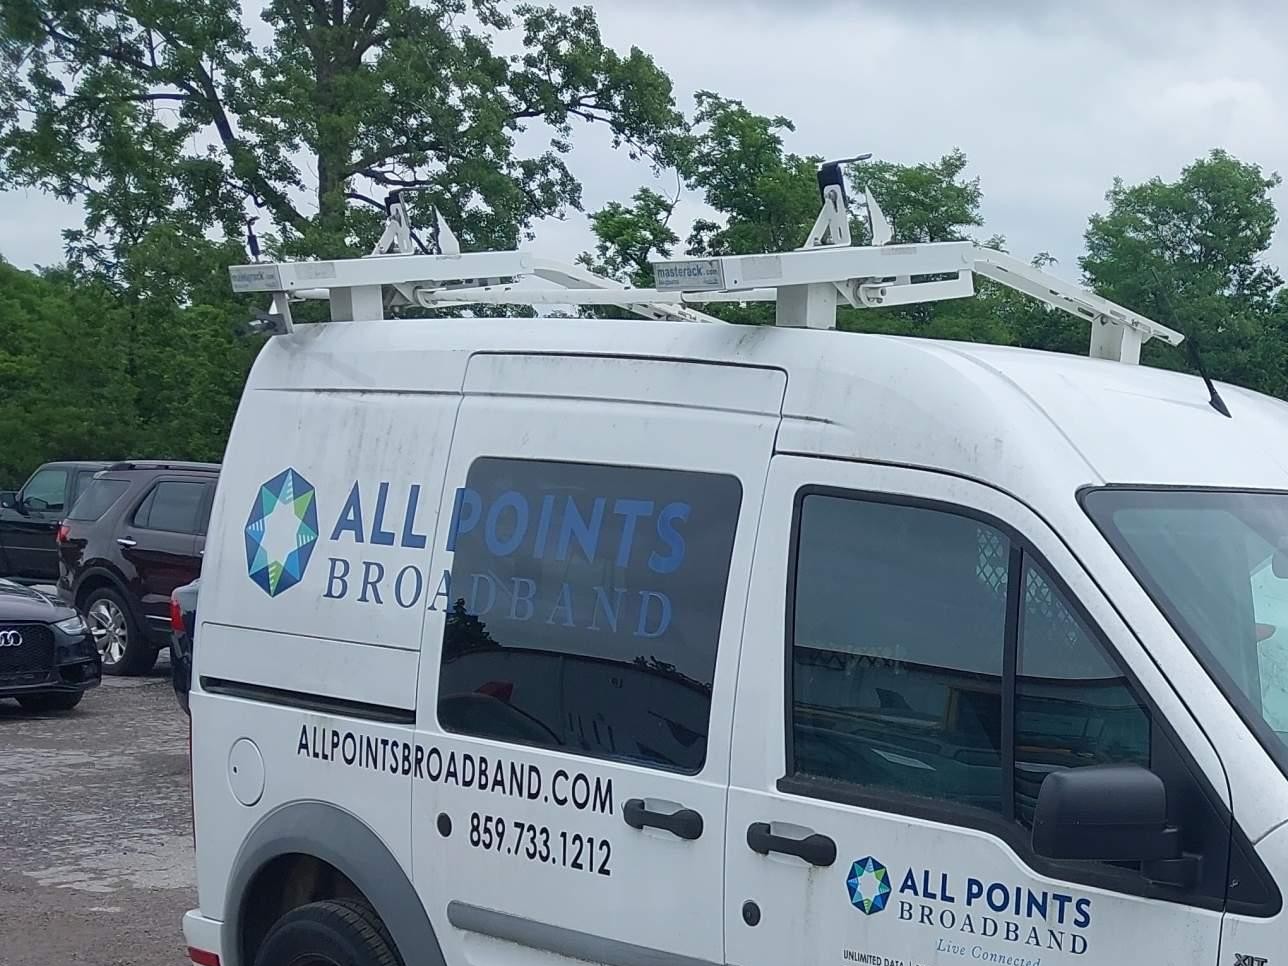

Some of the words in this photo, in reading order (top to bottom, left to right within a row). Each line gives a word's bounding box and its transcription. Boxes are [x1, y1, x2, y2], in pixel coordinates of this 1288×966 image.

[330, 480, 427, 549] ALL
[446, 487, 692, 574] POINTS
[323, 557, 672, 638] BROADBAND
[298, 724, 613, 815] ALLPOINTSBROADBAND.COM
[469, 812, 611, 876] 859.733.1212
[898, 900, 1088, 955] BROADBAND
[899, 867, 955, 903] ALL
[966, 878, 1091, 928] POINTS
[843, 949, 882, 966] UNLIMITED
[936, 938, 966, 956] Live
